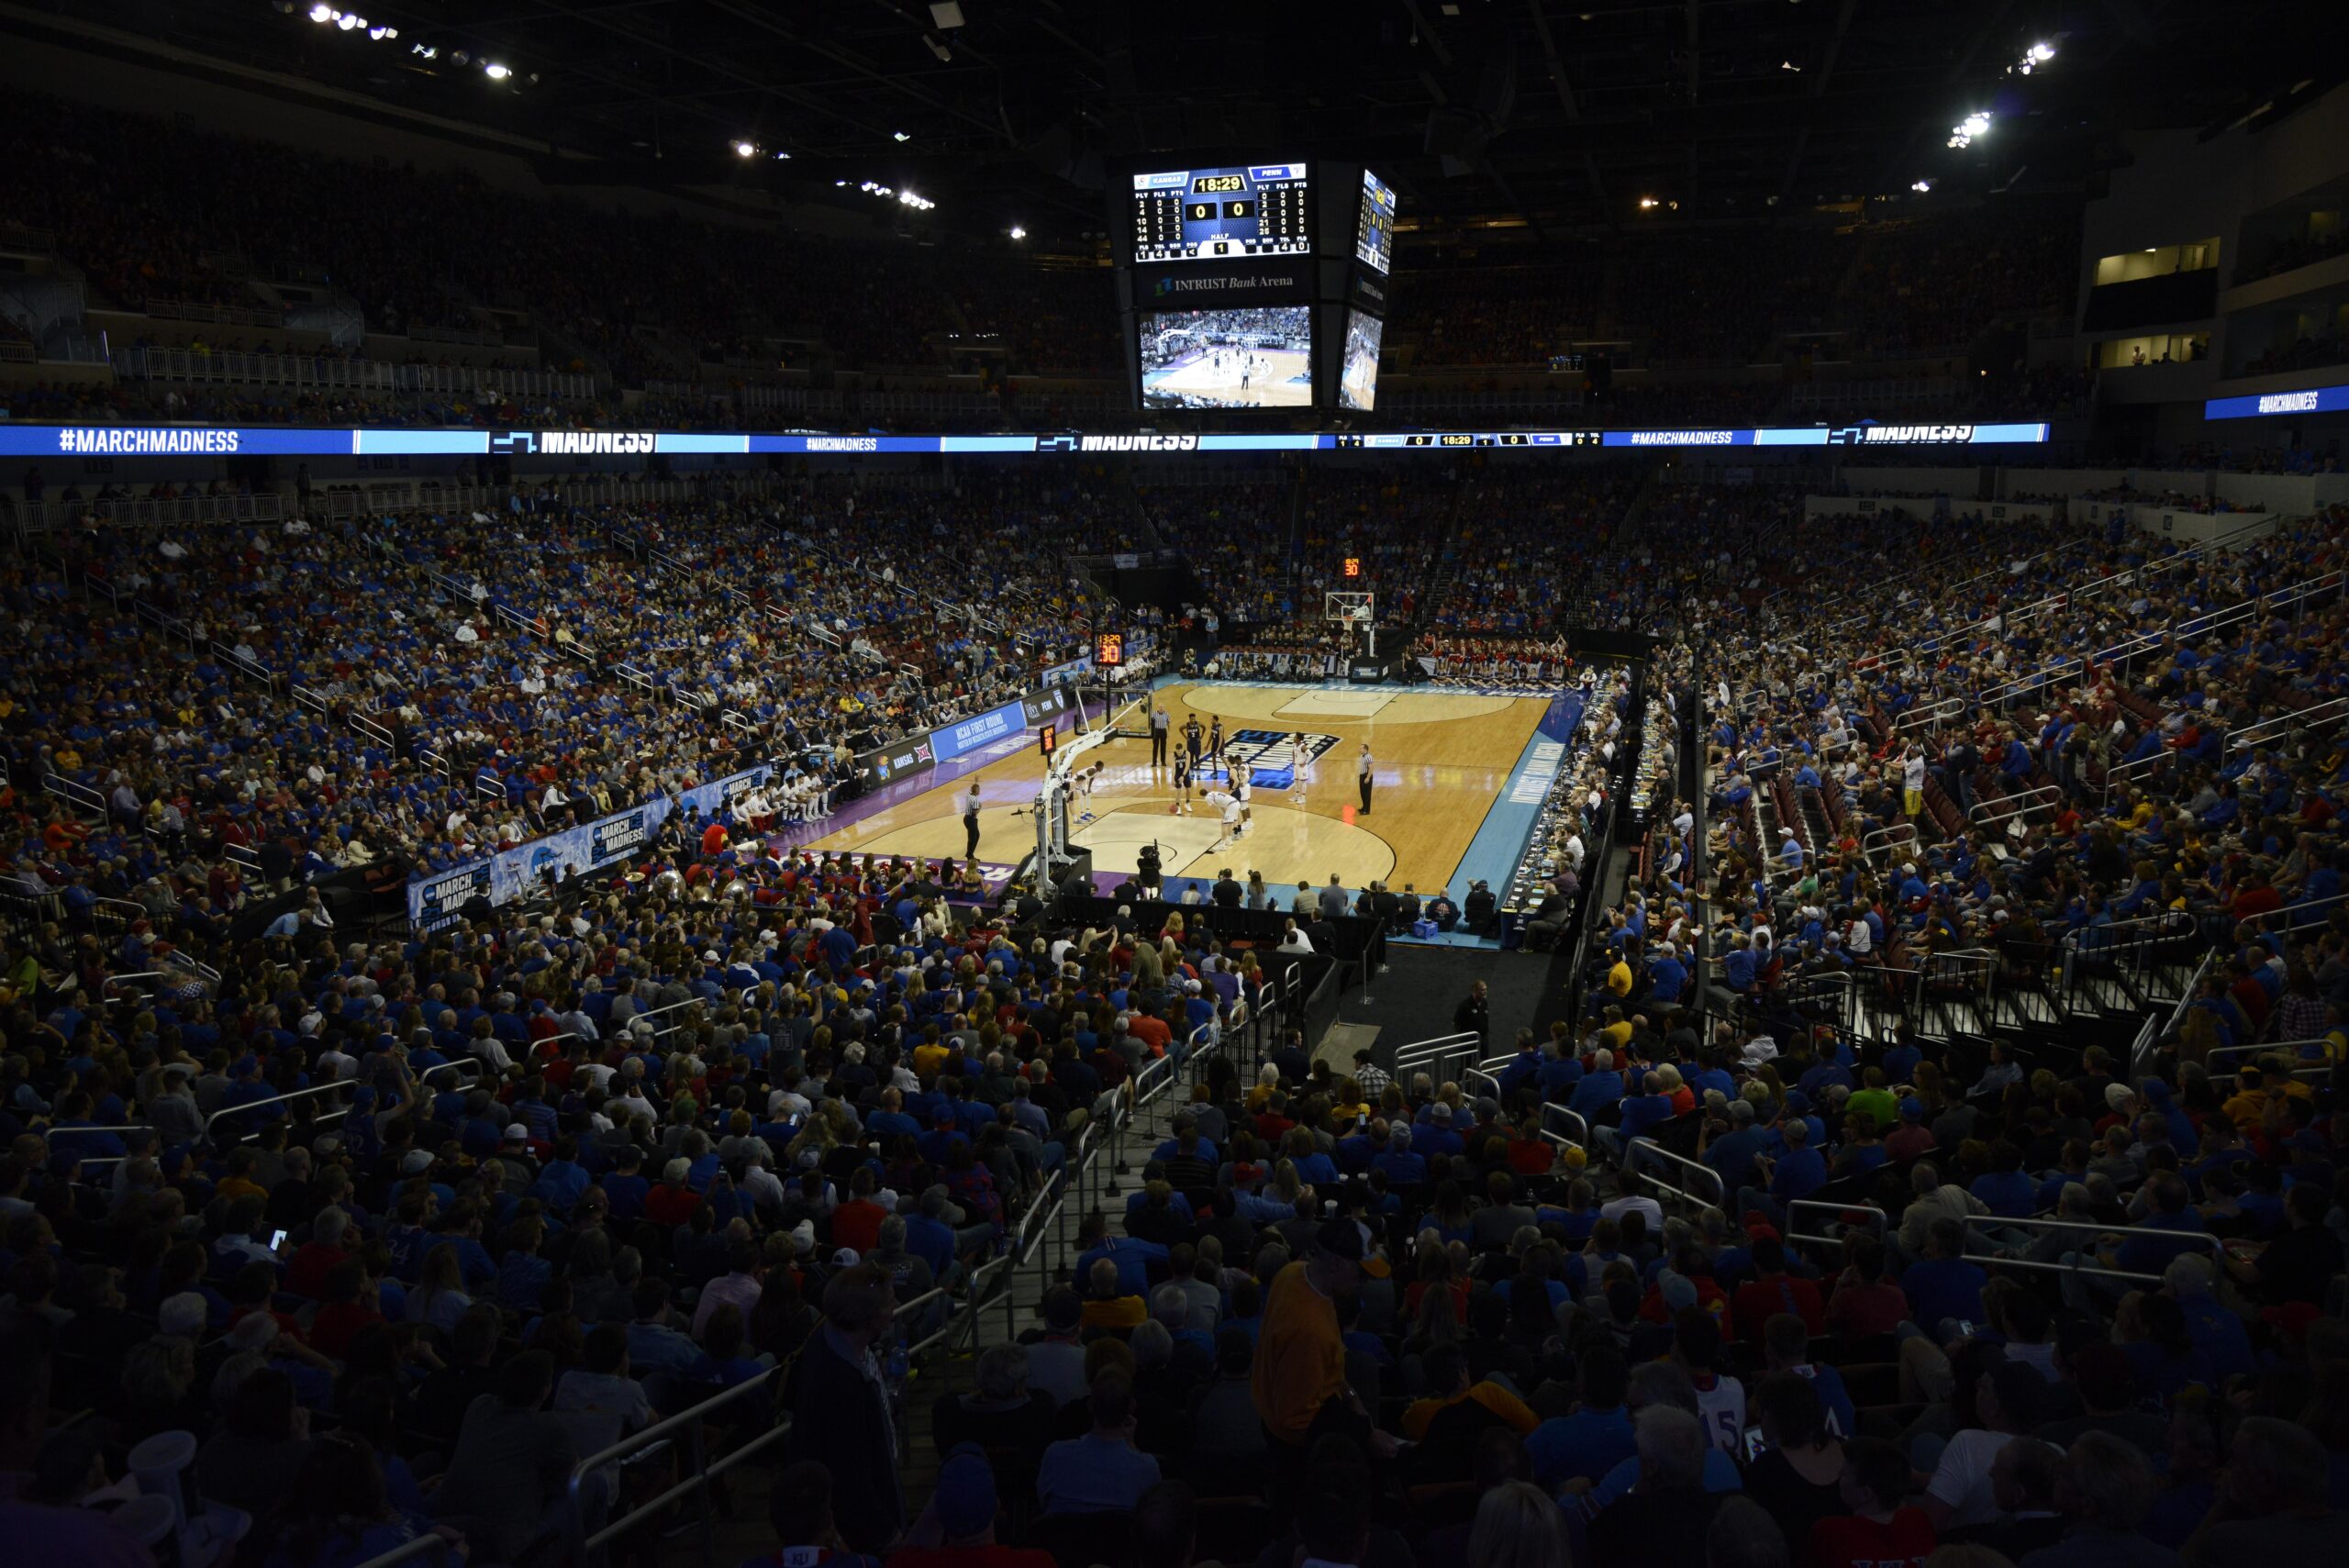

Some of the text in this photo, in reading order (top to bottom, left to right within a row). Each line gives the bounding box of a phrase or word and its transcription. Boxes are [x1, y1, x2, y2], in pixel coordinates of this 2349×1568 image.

[1198, 177, 1240, 192] 18:29
[1196, 206, 1206, 217] 0
[1234, 204, 1242, 216] 0
[1219, 244, 1223, 252] 1
[1175, 276, 1293, 291] INTRUST Bank Arena
[2258, 391, 2319, 413] #MARCHMADNESS
[60, 428, 238, 452] #MARCHMADNESS
[540, 433, 654, 453] MADNESS
[806, 437, 876, 451] #MARCHMADNESS
[1081, 436, 1196, 451] MADNESS
[1416, 436, 1423, 445] 0
[1442, 435, 1471, 445] 18:29
[1510, 435, 1519, 445] 0
[1631, 430, 1732, 445] #MARCHMADNESS
[1345, 565, 1358, 575] 30
[1100, 645, 1118, 662] 30
[971, 718, 986, 734] FIRST
[985, 713, 1004, 728] ROUND
[893, 753, 914, 770] KANSAS
[729, 777, 751, 795] MARCH
[601, 818, 629, 840] MARCH
[606, 827, 644, 852] MADNESS
[436, 873, 473, 900] MARCH
[792, 1552, 808, 1565] KU
